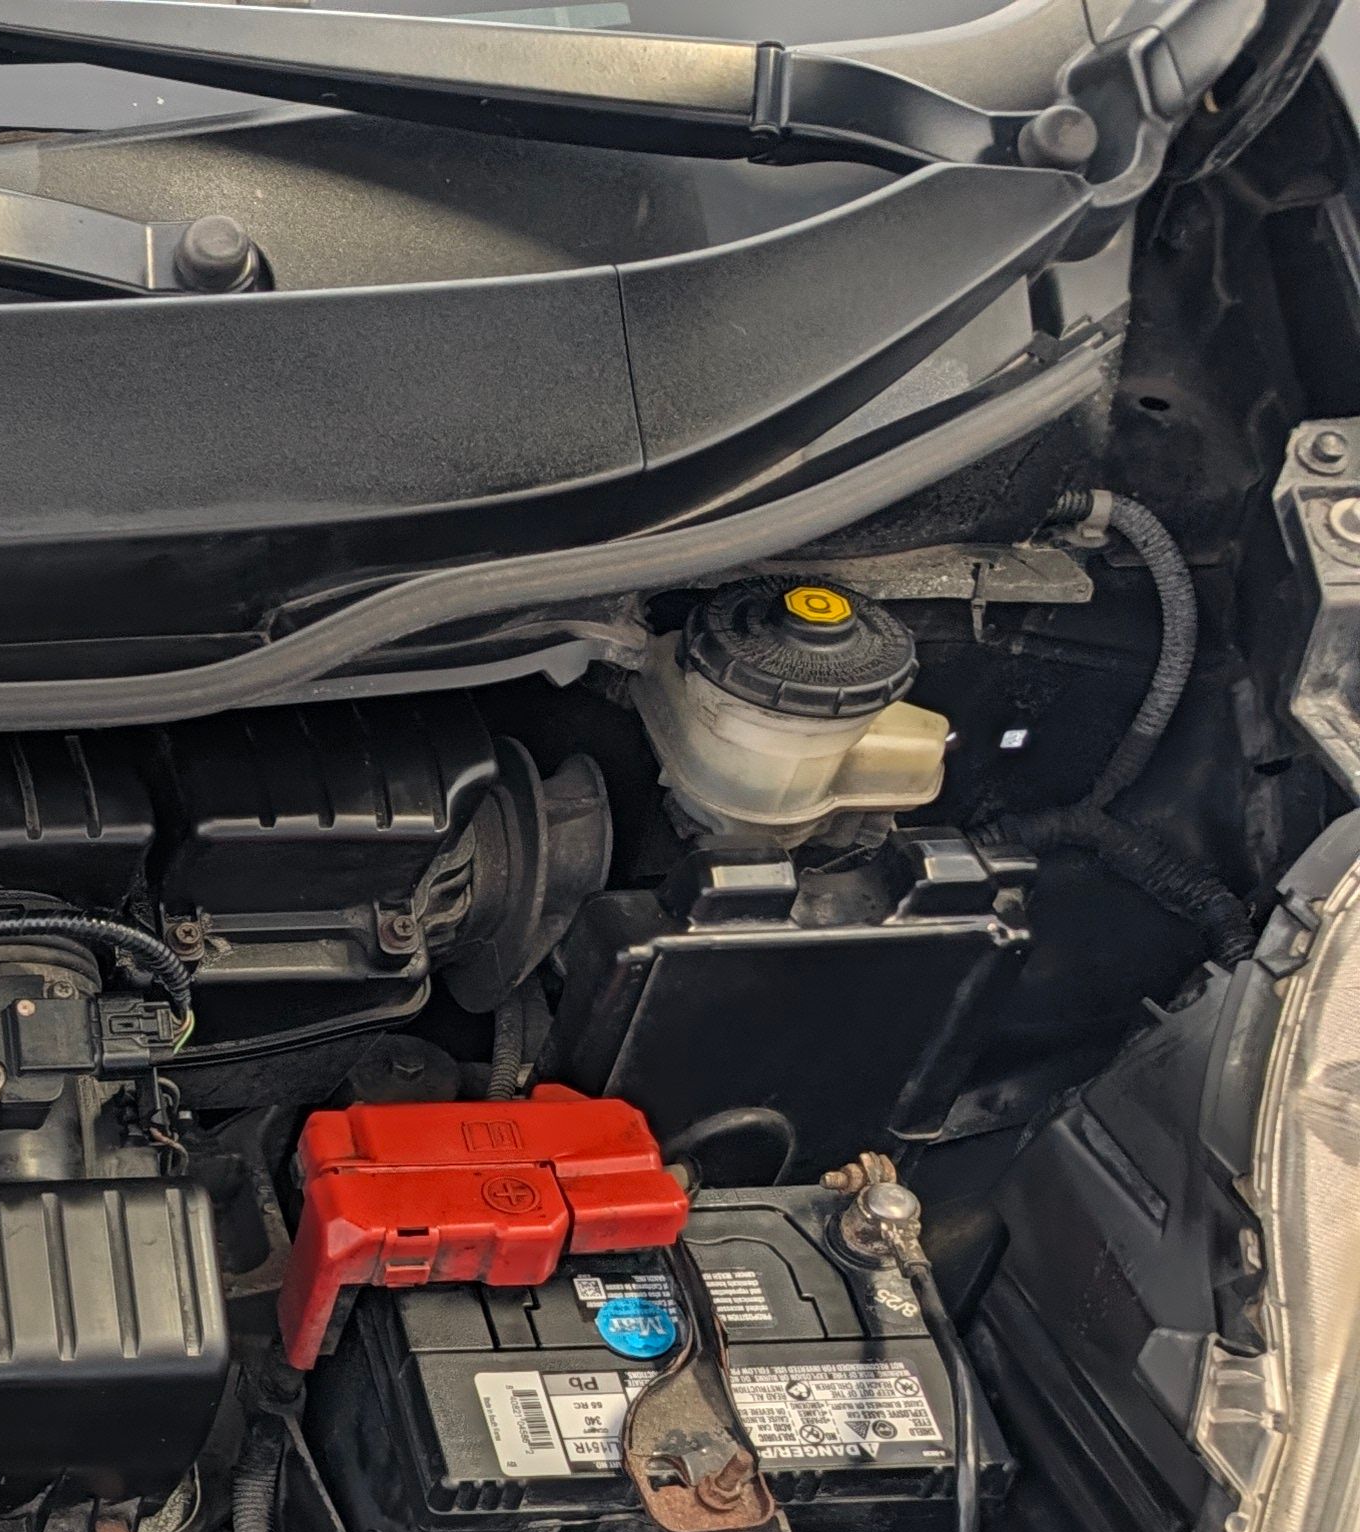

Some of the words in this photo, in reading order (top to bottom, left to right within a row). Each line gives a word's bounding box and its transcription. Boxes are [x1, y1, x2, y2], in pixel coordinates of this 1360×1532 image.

[874, 1289, 918, 1318] 8/25
[568, 1377, 600, 1392] Pb
[584, 1416, 603, 1426] 340
